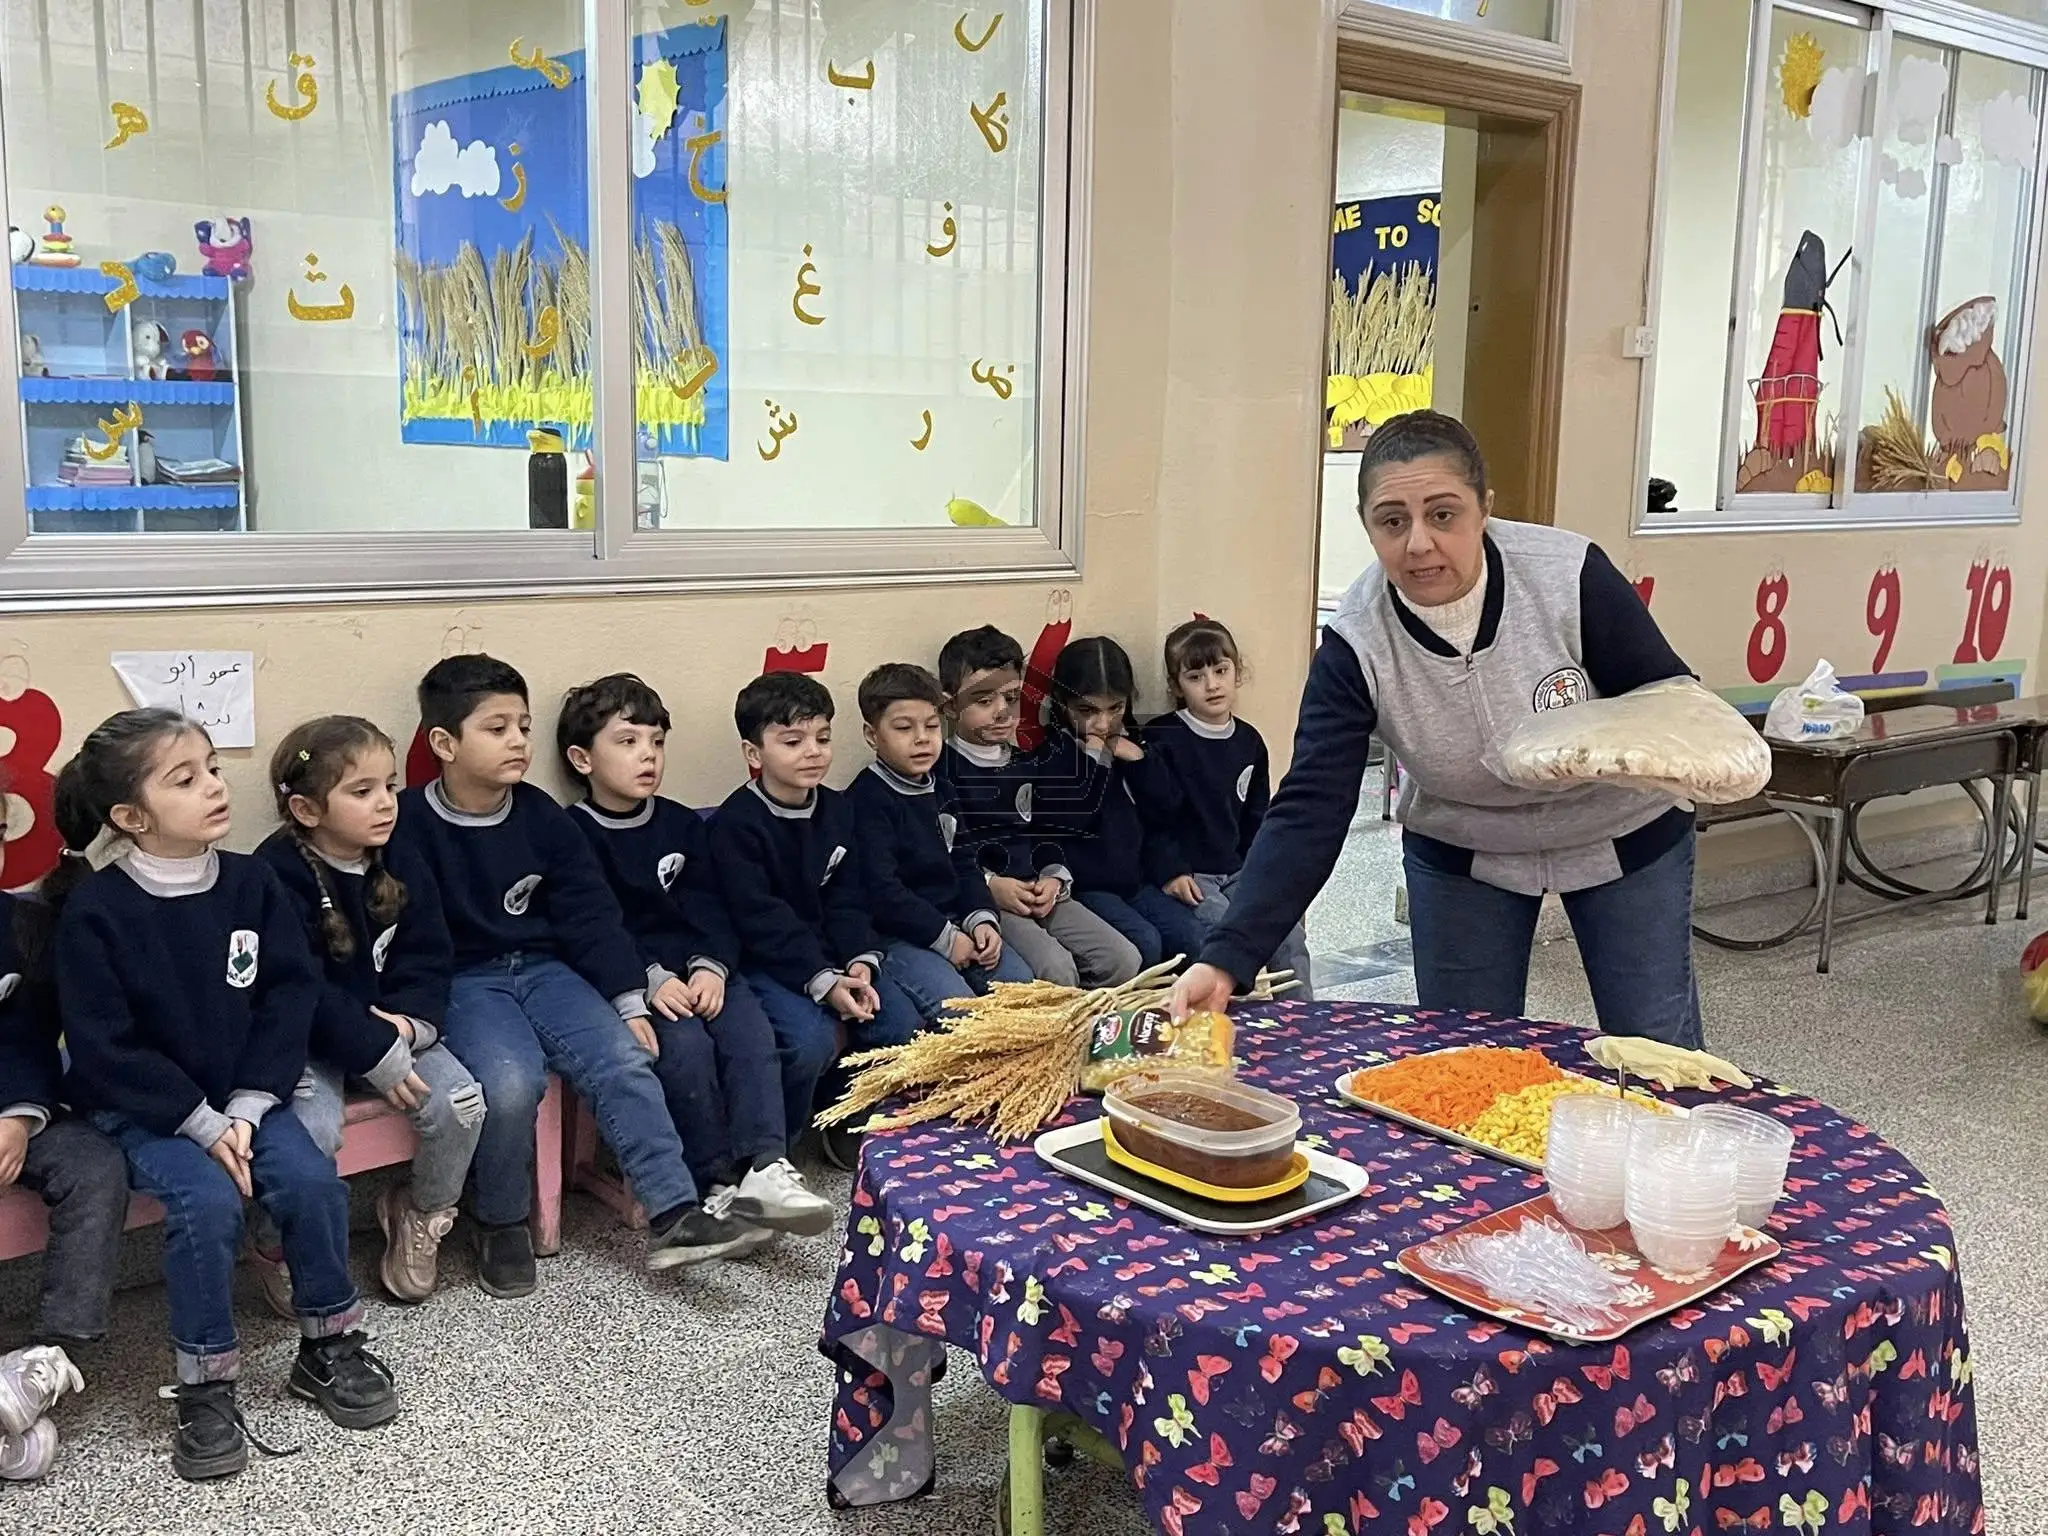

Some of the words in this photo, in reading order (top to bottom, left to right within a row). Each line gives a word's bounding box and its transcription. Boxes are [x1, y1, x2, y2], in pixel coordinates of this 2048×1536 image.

[266, 51, 318, 120] ق
[828, 59, 875, 105] ب
[498, 142, 527, 212] ز
[686, 115, 729, 203] خ
[926, 200, 957, 257] ف
[1374, 225, 1408, 249] TO
[100, 261, 141, 313] د
[287, 253, 355, 321] ث
[793, 243, 827, 325] غ
[522, 306, 560, 358] و
[971, 358, 1015, 400] ض
[82, 401, 143, 460] س
[758, 398, 798, 461] ش
[910, 410, 932, 450] ر
[1746, 572, 1789, 685] 8
[1866, 567, 1901, 675] 9
[1952, 558, 2012, 665] 10
[202, 663, 242, 687] عمو
